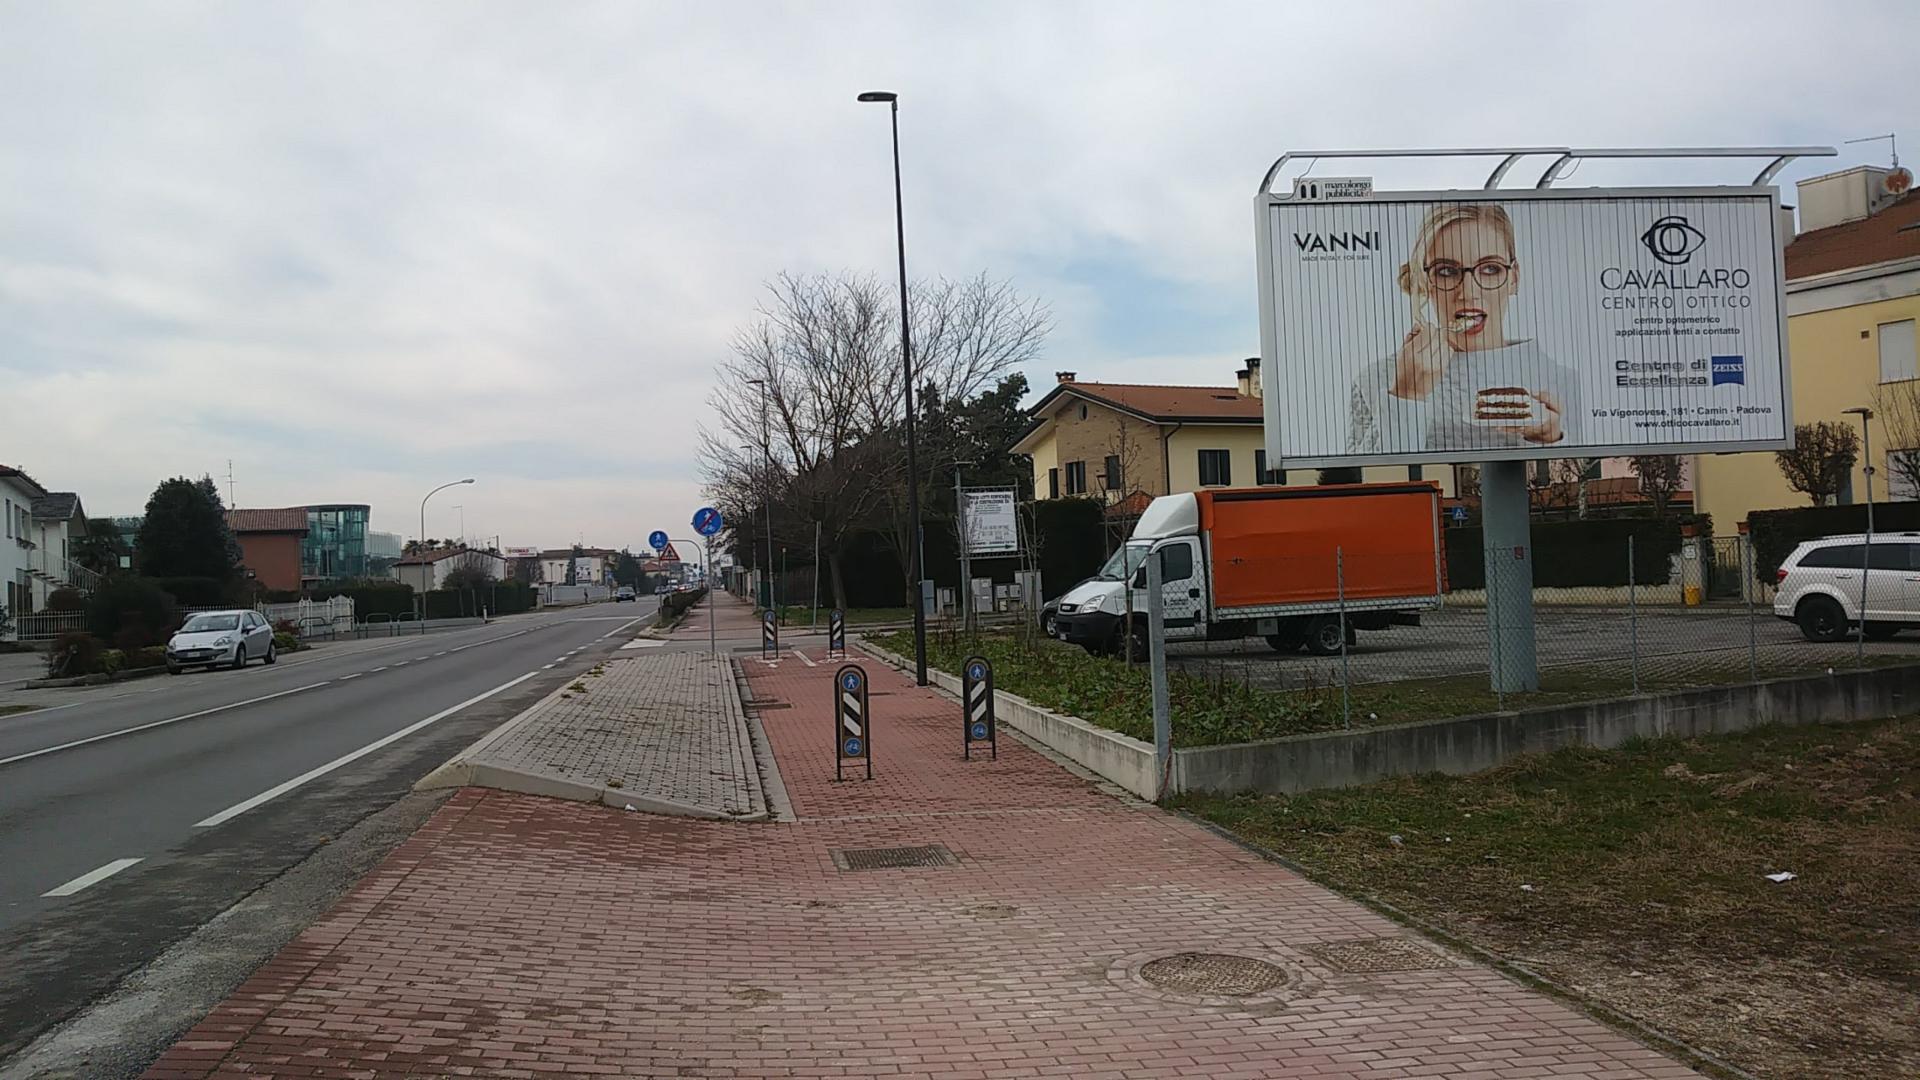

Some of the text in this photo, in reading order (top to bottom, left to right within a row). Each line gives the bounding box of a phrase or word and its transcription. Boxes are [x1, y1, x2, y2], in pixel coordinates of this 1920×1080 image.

[1324, 180, 1371, 190] marcolongo
[1293, 231, 1379, 252] VANNI
[1600, 267, 1750, 290] CAVALLARO
[1601, 295, 1750, 309] CENTRO OTTICO
[1634, 315, 1720, 325] centro optometrico
[1615, 328, 1671, 338] applicazioni
[1673, 327, 1693, 335] lenti
[1702, 327, 1741, 335] contatto
[1615, 359, 1707, 372] Centro di
[1713, 364, 1743, 372] ZEISS
[1616, 375, 1708, 387] Eccellenza
[1592, 408, 1607, 417] Via
[1672, 407, 1688, 416] 181
[1697, 406, 1728, 415] Camin
[1736, 406, 1772, 415] Padova
[1634, 418, 1740, 428] www.otticocavallaro.it
